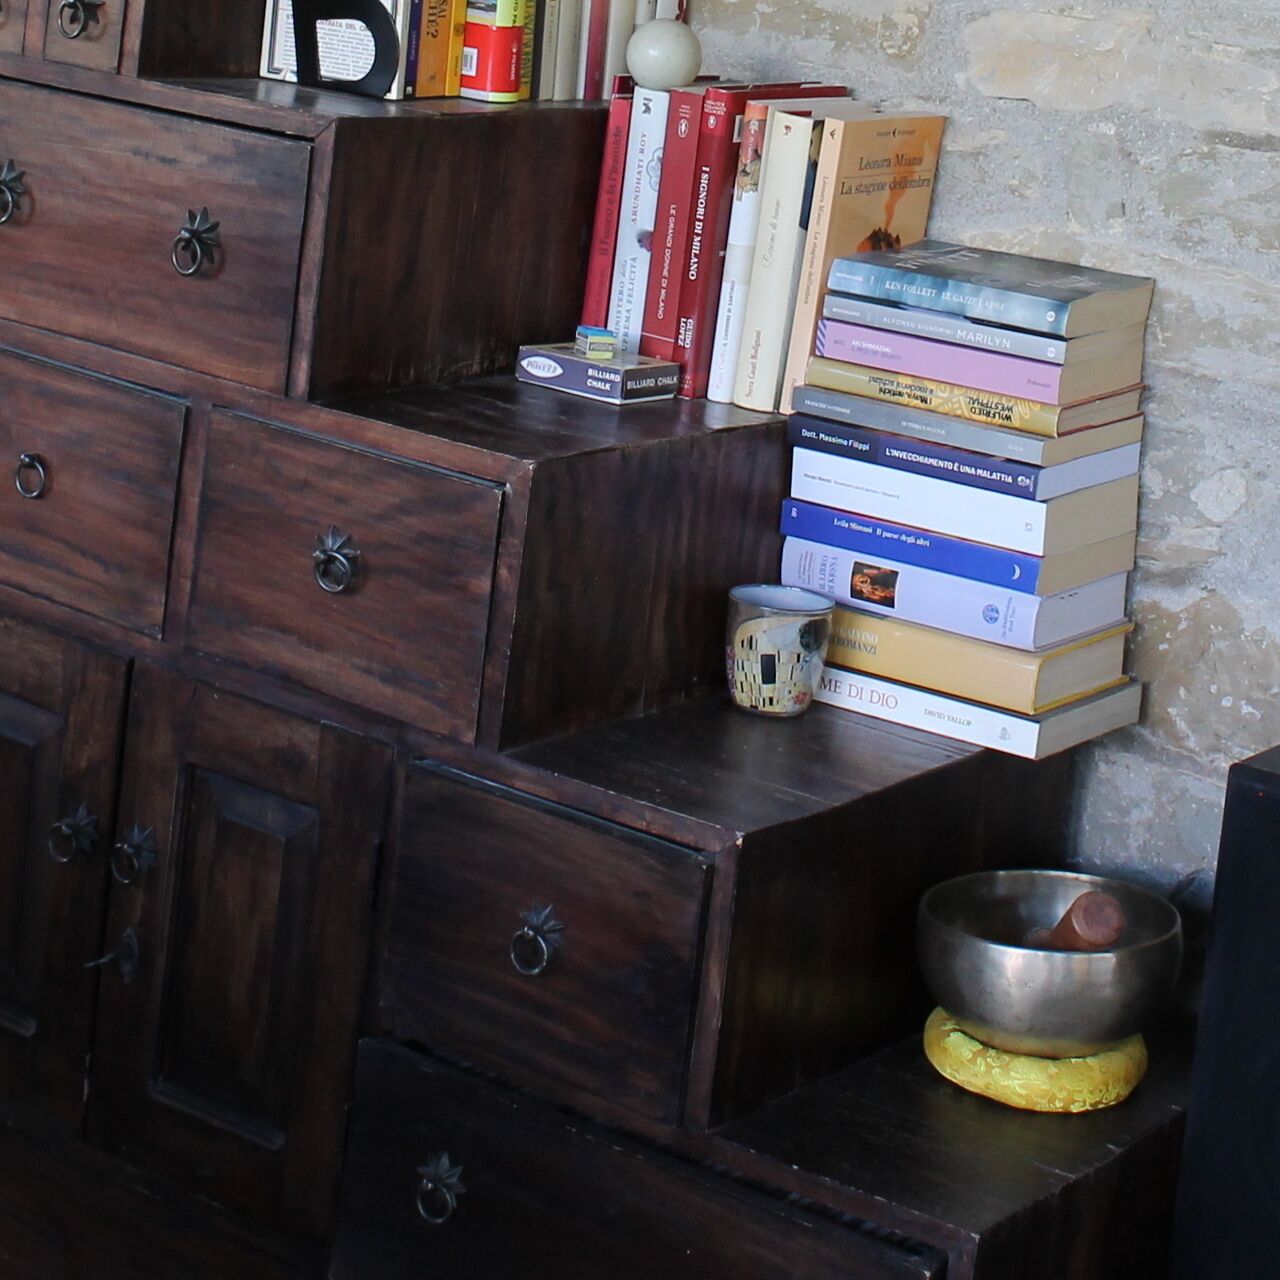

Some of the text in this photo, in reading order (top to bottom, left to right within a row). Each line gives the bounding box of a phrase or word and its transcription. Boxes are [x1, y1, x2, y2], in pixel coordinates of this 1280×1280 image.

[858, 153, 922, 171] Léonora Miano
[629, 131, 649, 224] ARUNDHATI ROY
[840, 181, 888, 197] La stagione
[696, 173, 710, 220] SIGNORI
[664, 216, 676, 247] GRANDI
[694, 222, 704, 234] DI
[661, 248, 671, 277] DONNE
[688, 235, 702, 280] MILANO
[622, 255, 640, 305] FELICITÀ
[885, 280, 901, 290] KEN
[902, 284, 937, 297] FOLLETT
[656, 288, 667, 319] MILANO
[677, 317, 687, 347] LOPEZ
[683, 318, 694, 349] GUIDO
[748, 328, 764, 361] Modignani
[883, 317, 916, 328] ALFONSO
[956, 328, 1011, 349] MARILYN
[586, 379, 612, 392] CHALK
[587, 368, 621, 383] BILLIARD
[626, 375, 679, 390] BILLIARD CHALK
[867, 376, 895, 388] schiavi
[895, 381, 928, 395] moderni
[878, 387, 904, 399] antichi
[967, 396, 1014, 413] WESTPHAL
[970, 406, 1013, 423] WILFRIED
[801, 428, 870, 451] Dott. Massimo Filippi
[885, 447, 953, 471] L'INVECCHIAMENTO
[959, 465, 976, 476] UNA
[976, 468, 1013, 484] MALATTIA
[833, 517, 849, 529] Leila
[900, 531, 916, 544] degli
[916, 536, 931, 548] altri
[837, 637, 877, 656] ROMANZI
[847, 683, 973, 728] DI DIO DAVID YALLOP
